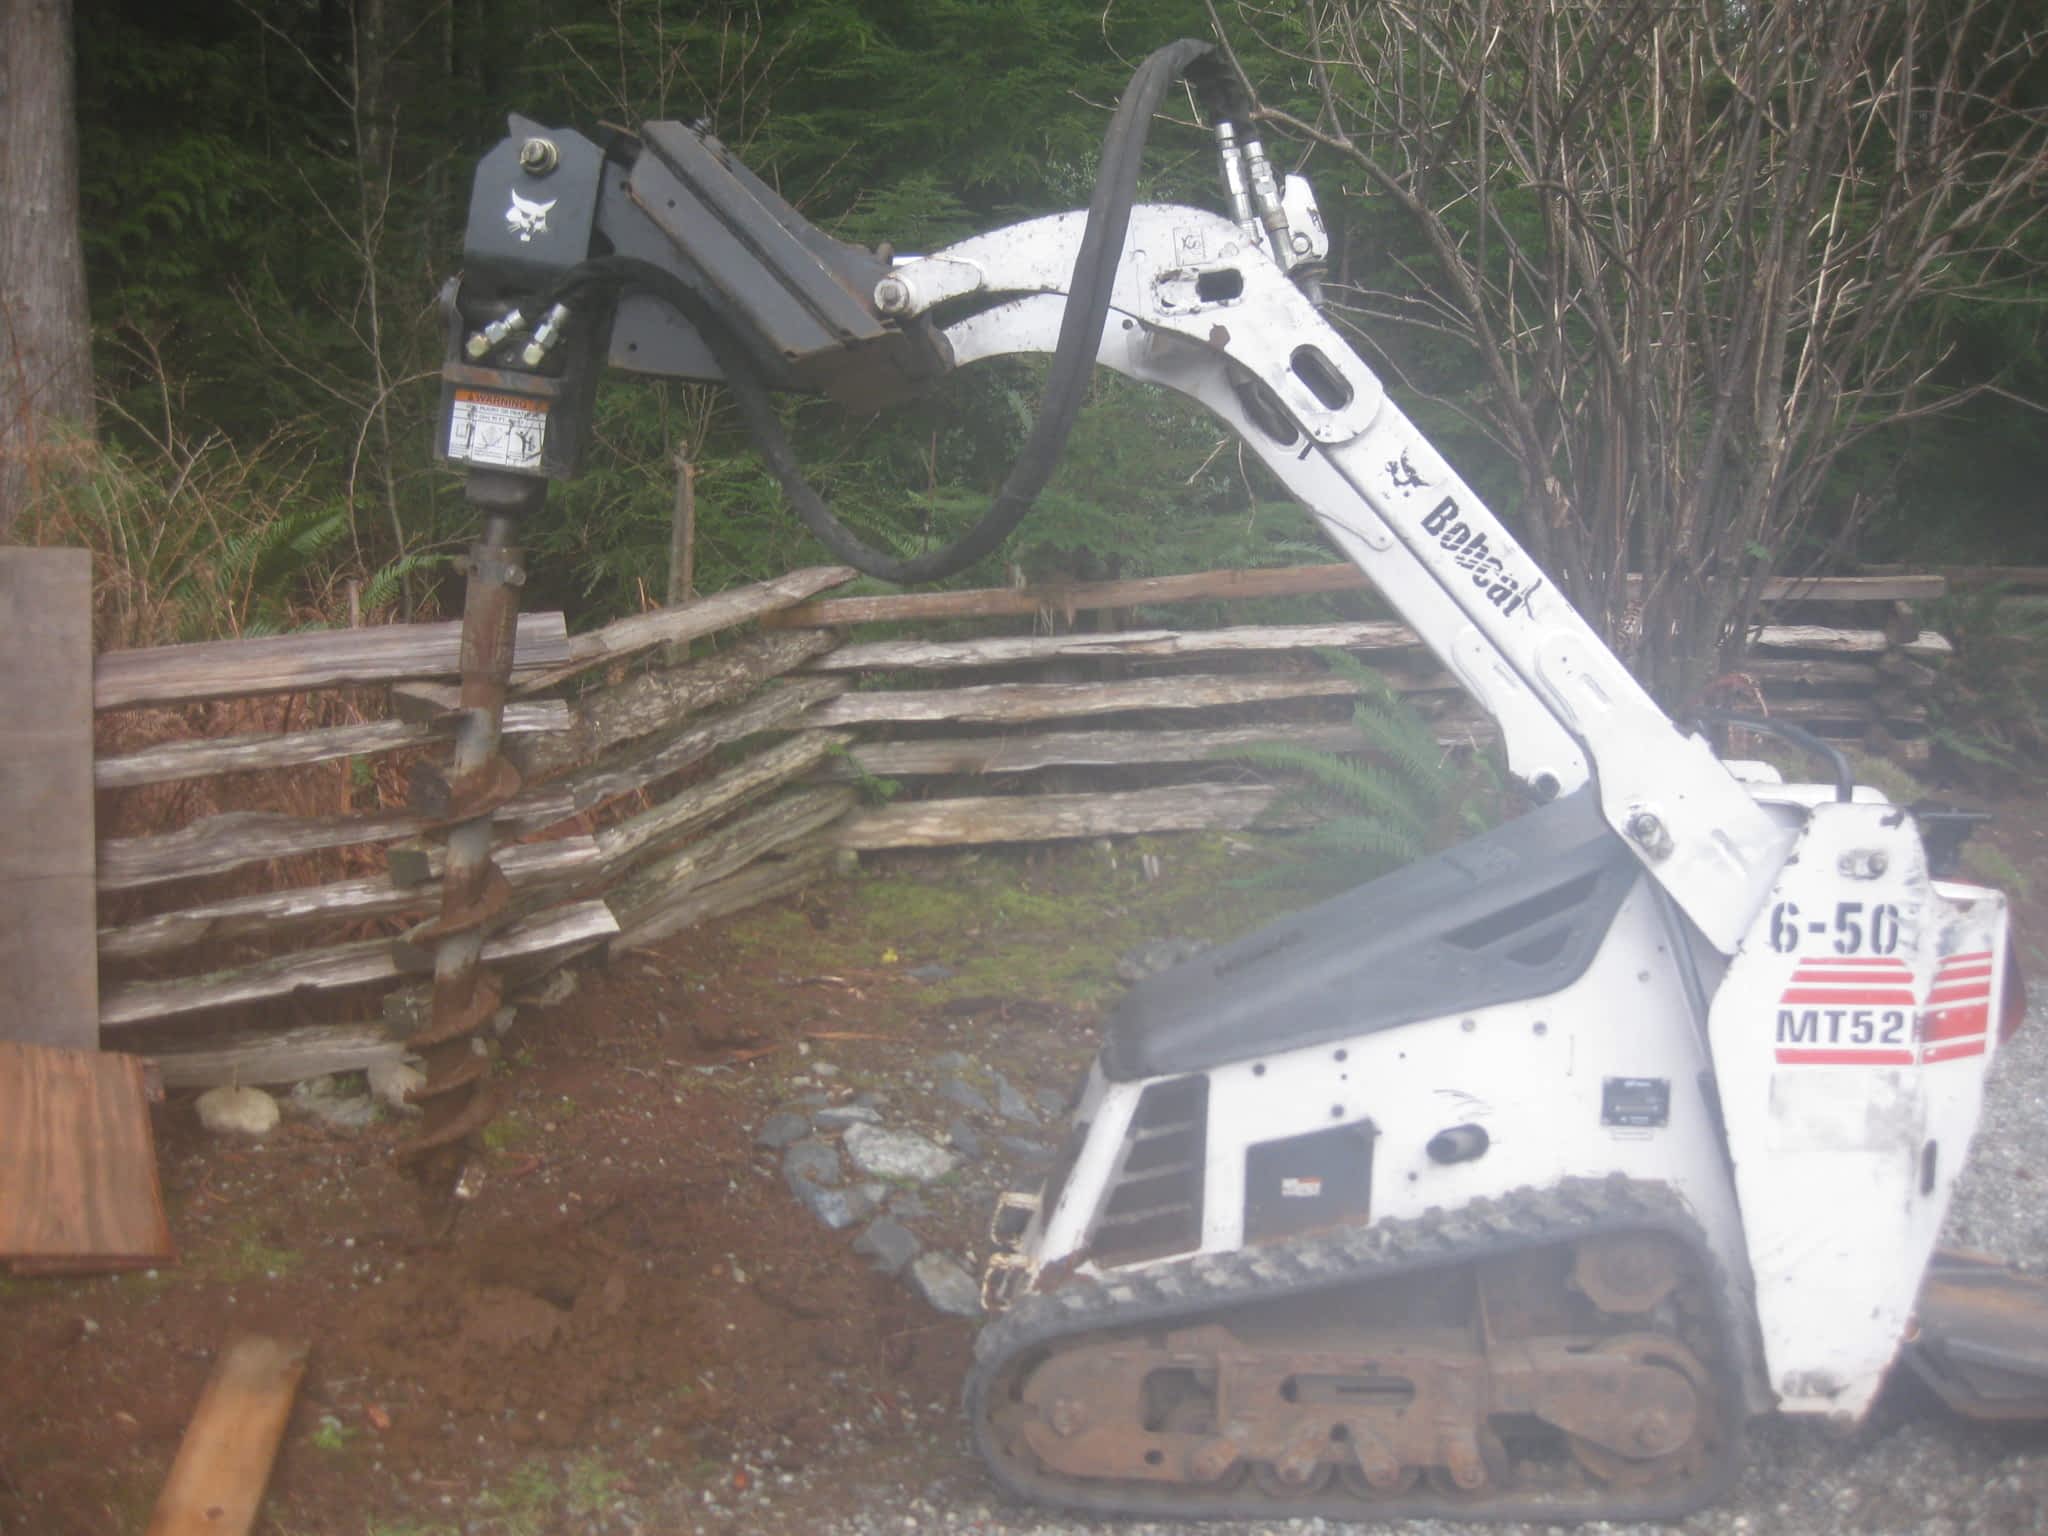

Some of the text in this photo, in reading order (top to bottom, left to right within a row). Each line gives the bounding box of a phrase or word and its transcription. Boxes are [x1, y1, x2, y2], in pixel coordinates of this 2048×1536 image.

[1420, 495, 1525, 618] Bobcat
[1770, 902, 1899, 955] 6-50
[1776, 1010, 1905, 1044] MT52
